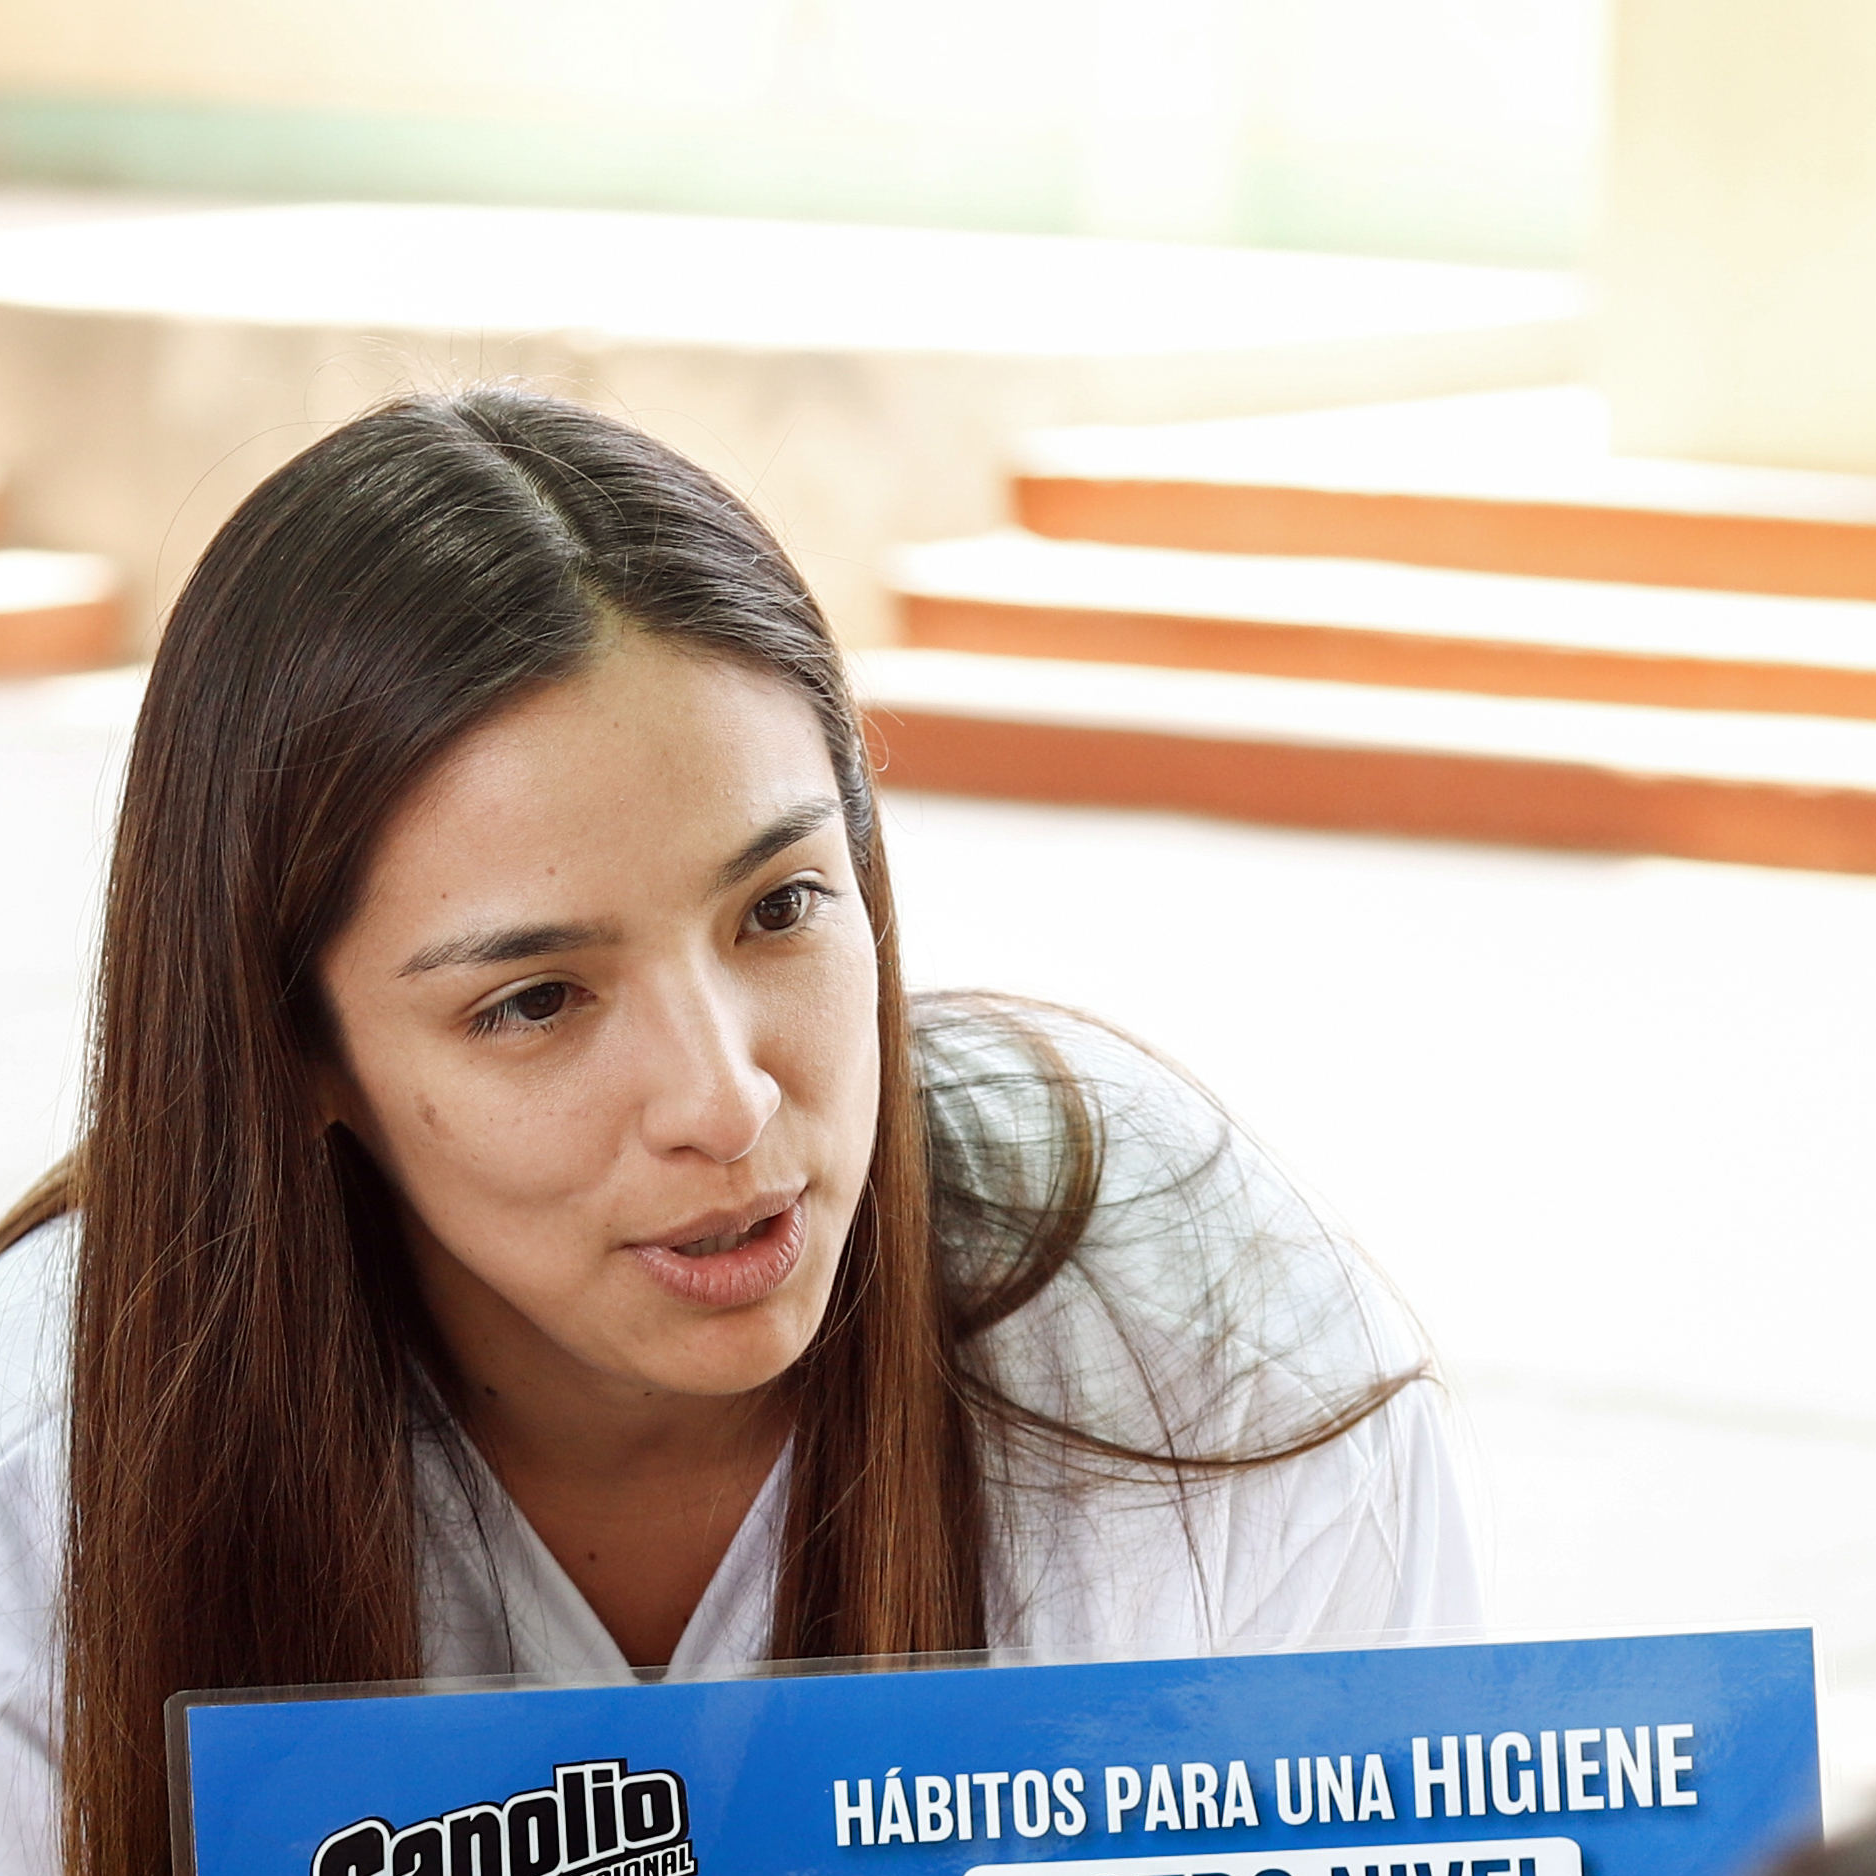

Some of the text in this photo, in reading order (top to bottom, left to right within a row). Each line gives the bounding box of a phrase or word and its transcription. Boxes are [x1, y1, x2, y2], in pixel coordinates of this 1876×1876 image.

[834, 1723, 1699, 1847] HÁBITOS PARA UNA HIGIENE
